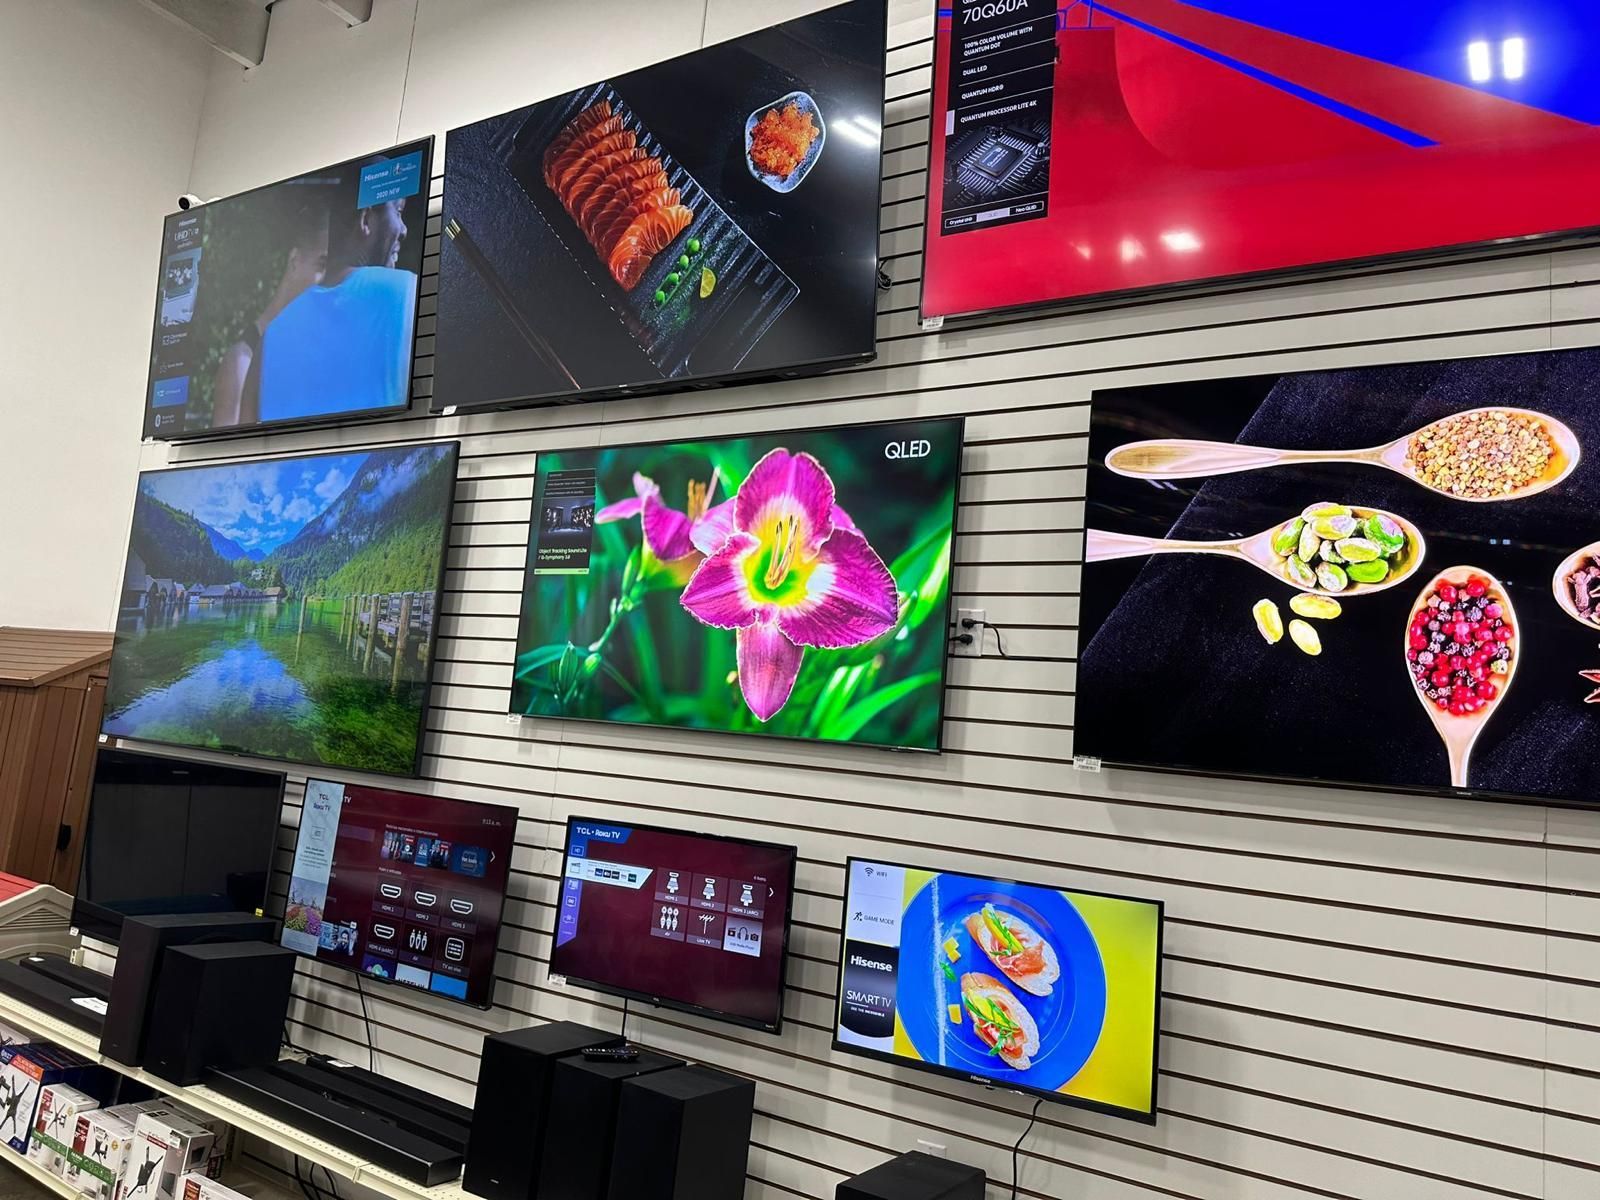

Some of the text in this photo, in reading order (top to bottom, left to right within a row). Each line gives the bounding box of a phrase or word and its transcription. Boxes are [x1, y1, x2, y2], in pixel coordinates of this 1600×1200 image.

[962, 0, 1029, 25] 70Q60A
[964, 26, 1033, 49] 100% COLOR VOLUME WITH
[963, 41, 1001, 56] QUANTUM DOT
[962, 65, 988, 76] DUAL LED
[961, 89, 988, 100] QUANTUM
[960, 111, 987, 123] QUANTUM
[987, 104, 1018, 117] PROCESSOR
[1017, 101, 1029, 110] LITE
[364, 170, 389, 182] Hisense
[885, 440, 931, 459] QLED
[318, 793, 329, 801] TCL
[576, 826, 621, 839] TCL Roku TV
[864, 914, 895, 926] GAME MODE
[850, 954, 893, 972] Hisense
[846, 989, 892, 1008] SMART TV
[970, 1074, 992, 1084] Hisense
